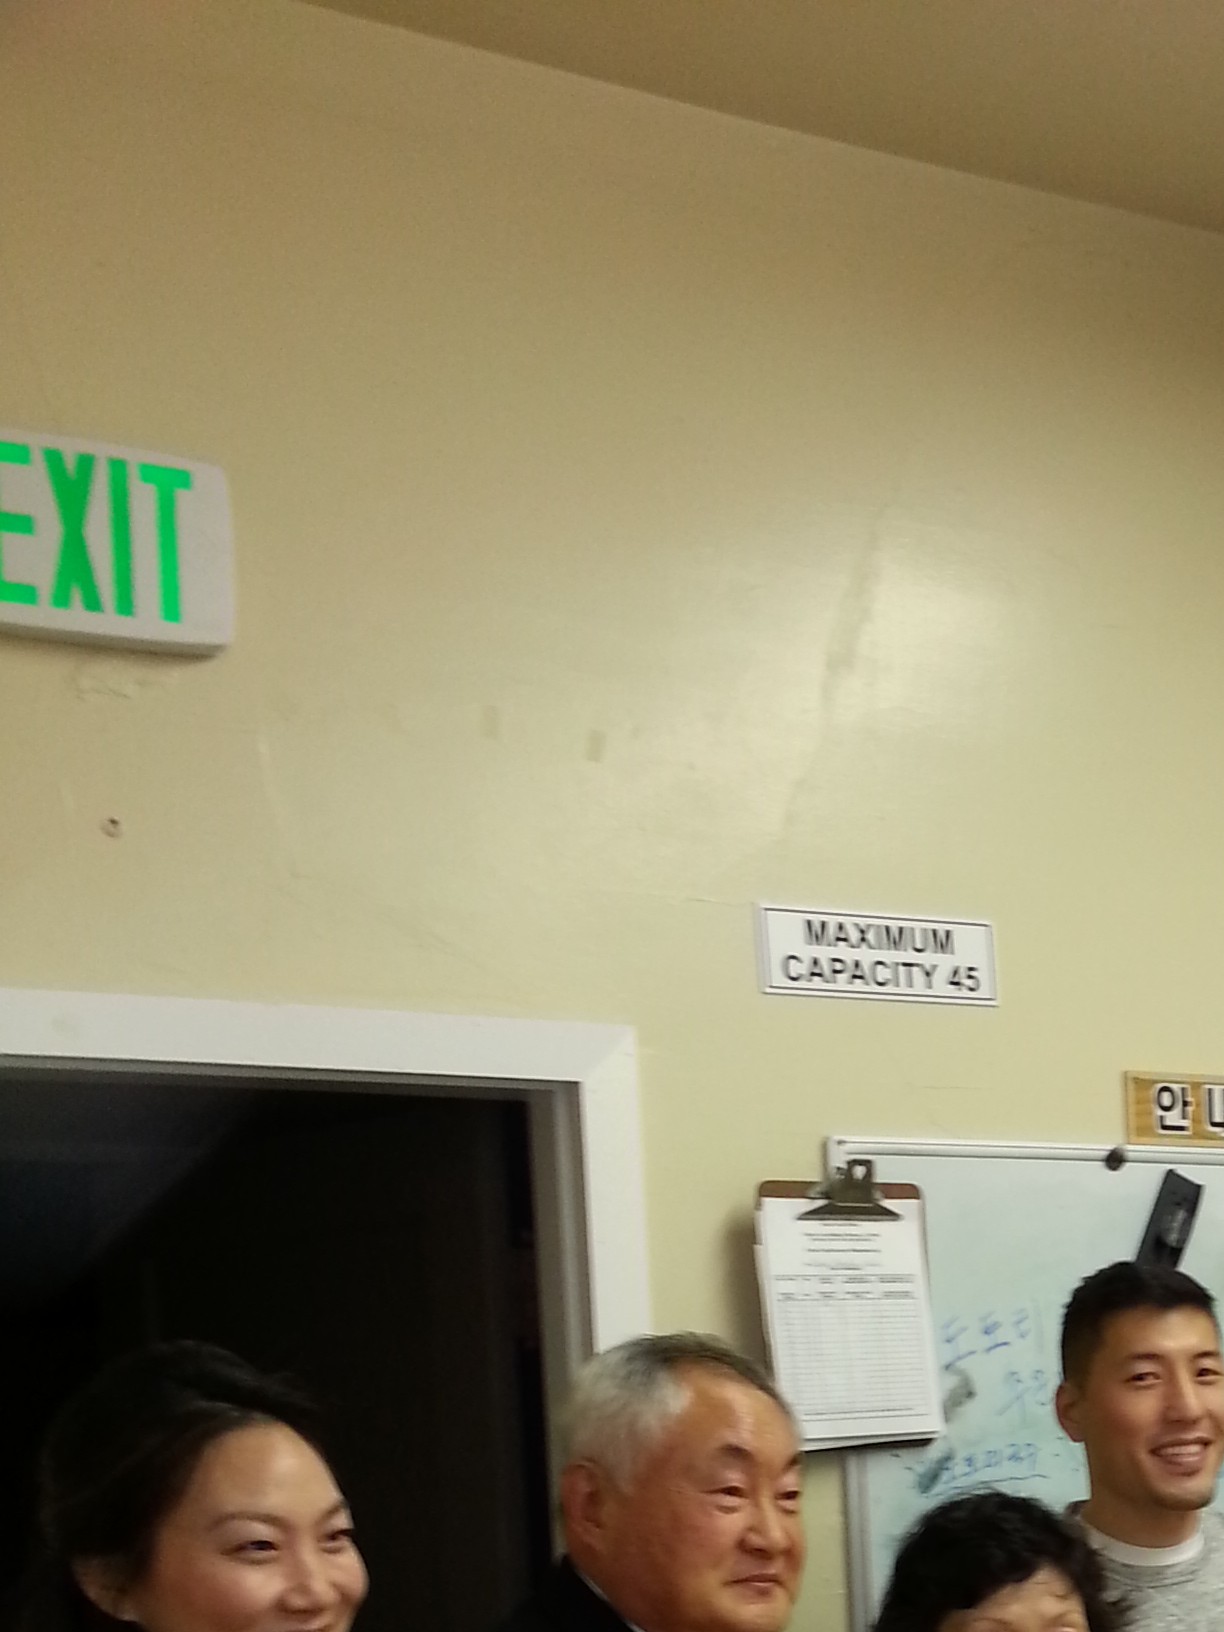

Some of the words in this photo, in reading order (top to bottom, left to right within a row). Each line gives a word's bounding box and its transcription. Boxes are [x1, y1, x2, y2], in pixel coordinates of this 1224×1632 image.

[0, 440, 192, 623] EXIT
[803, 919, 955, 955] MAXIMUM
[781, 954, 939, 990] CAPACITY
[947, 966, 981, 992] 45
